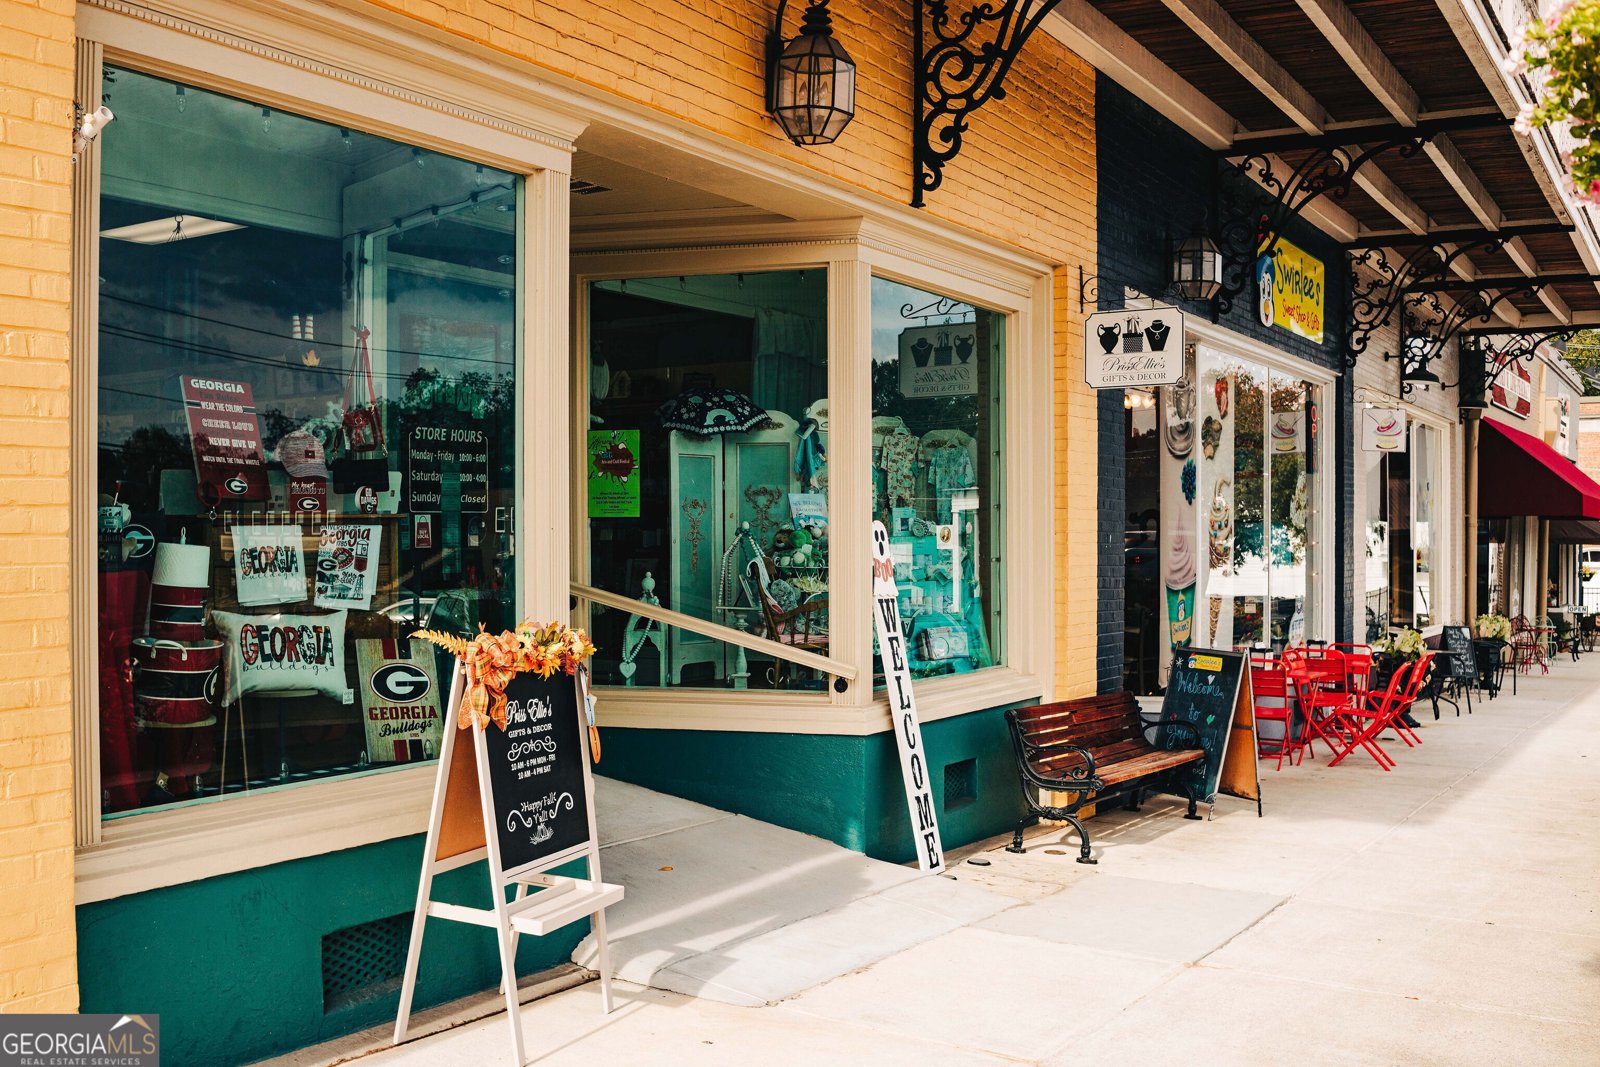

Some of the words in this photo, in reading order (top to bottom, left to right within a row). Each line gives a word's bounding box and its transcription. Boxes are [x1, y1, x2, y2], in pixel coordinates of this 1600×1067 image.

[1102, 375, 1128, 383] GIFTS
[1137, 372, 1166, 381] DECOR
[190, 378, 245, 394] GEORGIA
[208, 436, 230, 447] NEVER
[415, 427, 446, 440] STORE
[450, 429, 482, 443] HOURS
[411, 449, 434, 462] Monday
[438, 450, 454, 463] Friday
[460, 453, 472, 462] 10:00
[412, 470, 444, 484] Saturday
[412, 492, 441, 504] Sunday
[460, 494, 486, 503] Closed
[320, 528, 371, 547] Georgia
[240, 545, 298, 576] GEORGIA
[873, 558, 894, 582] BOO
[240, 623, 335, 667] GEORGIA
[242, 660, 330, 676] bulldogs
[368, 706, 438, 720] GEORGIA
[1188, 702, 1200, 721] to
[378, 720, 433, 738] Bulldogs
[508, 728, 526, 738] GIFTS
[527, 727, 532, 735] &
[532, 723, 552, 734] DECOR
[878, 598, 941, 870] WELCOME
[511, 763, 516, 771] 10
[516, 762, 524, 770] AM
[530, 760, 536, 768] PM
[537, 757, 546, 766] MON
[518, 772, 523, 780] 10
[524, 770, 531, 778] AM
[537, 768, 544, 776] PM
